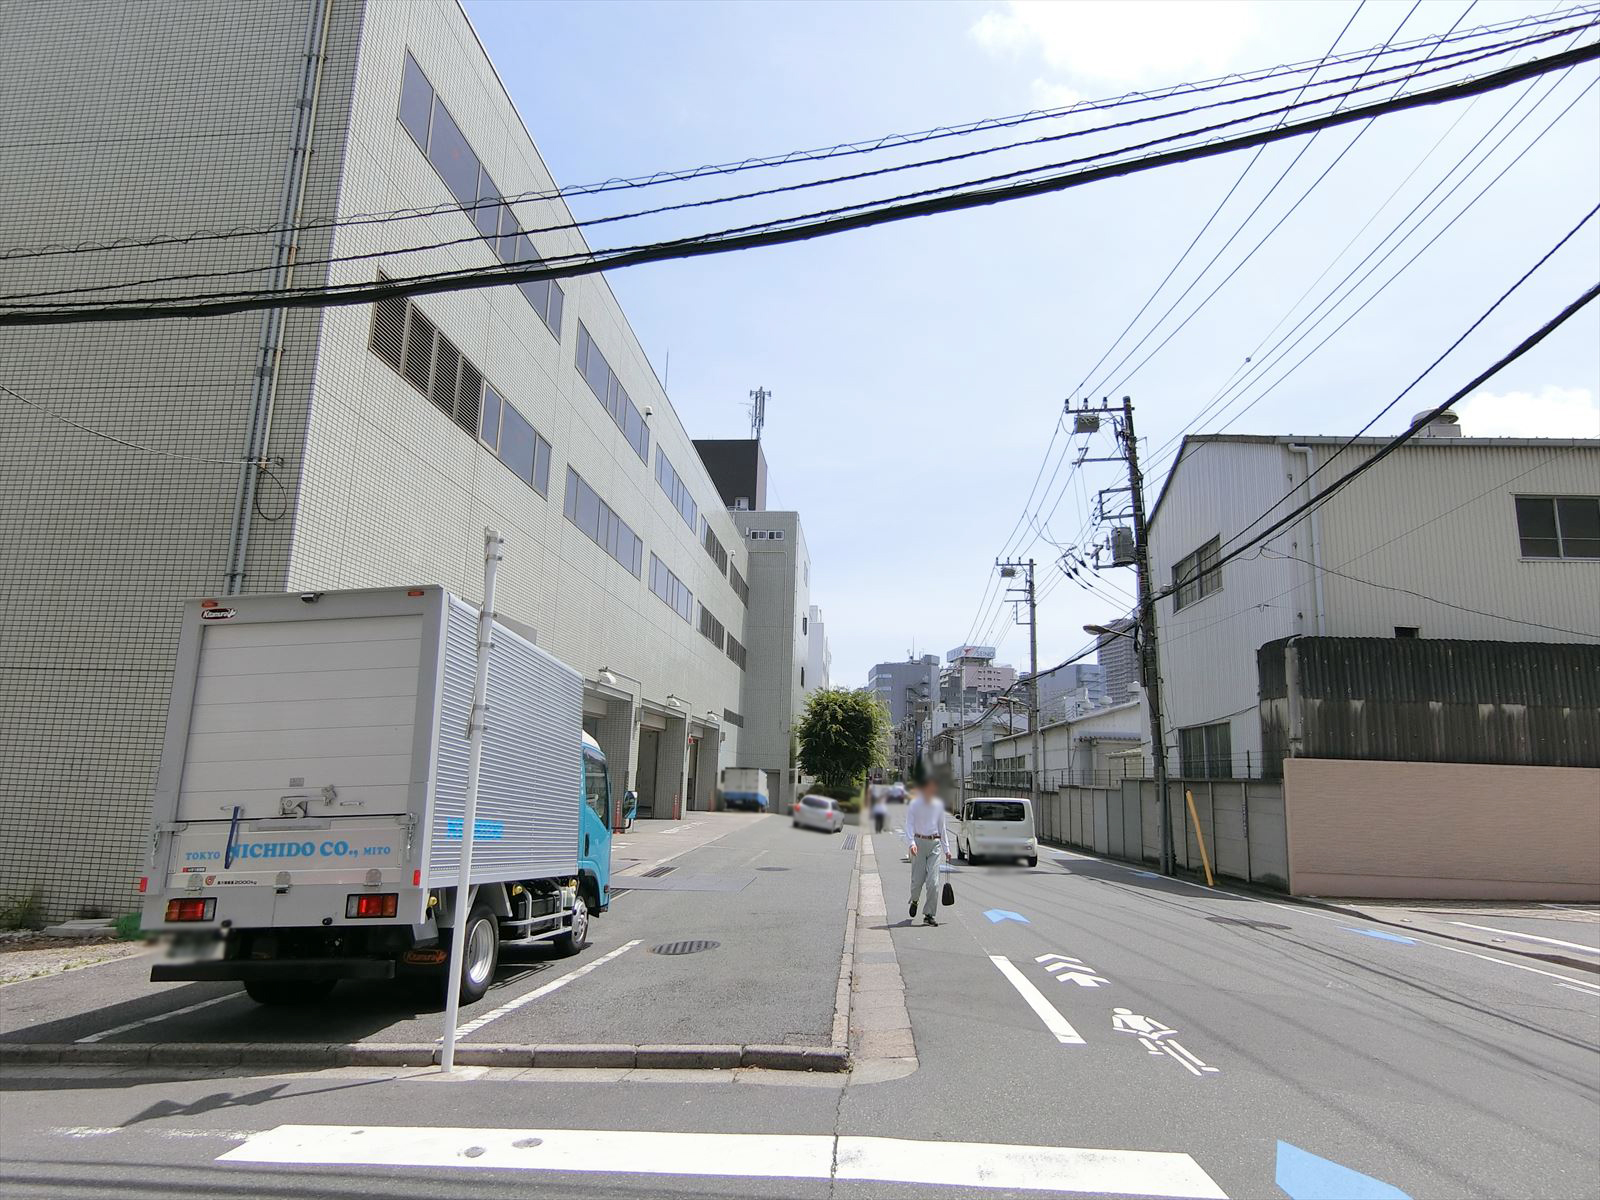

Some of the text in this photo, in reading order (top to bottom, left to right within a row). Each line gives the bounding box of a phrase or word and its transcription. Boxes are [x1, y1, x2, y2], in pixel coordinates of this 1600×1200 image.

[186, 851, 221, 860] TOKYO
[319, 840, 358, 857] CO.,
[363, 846, 391, 855] MITO
